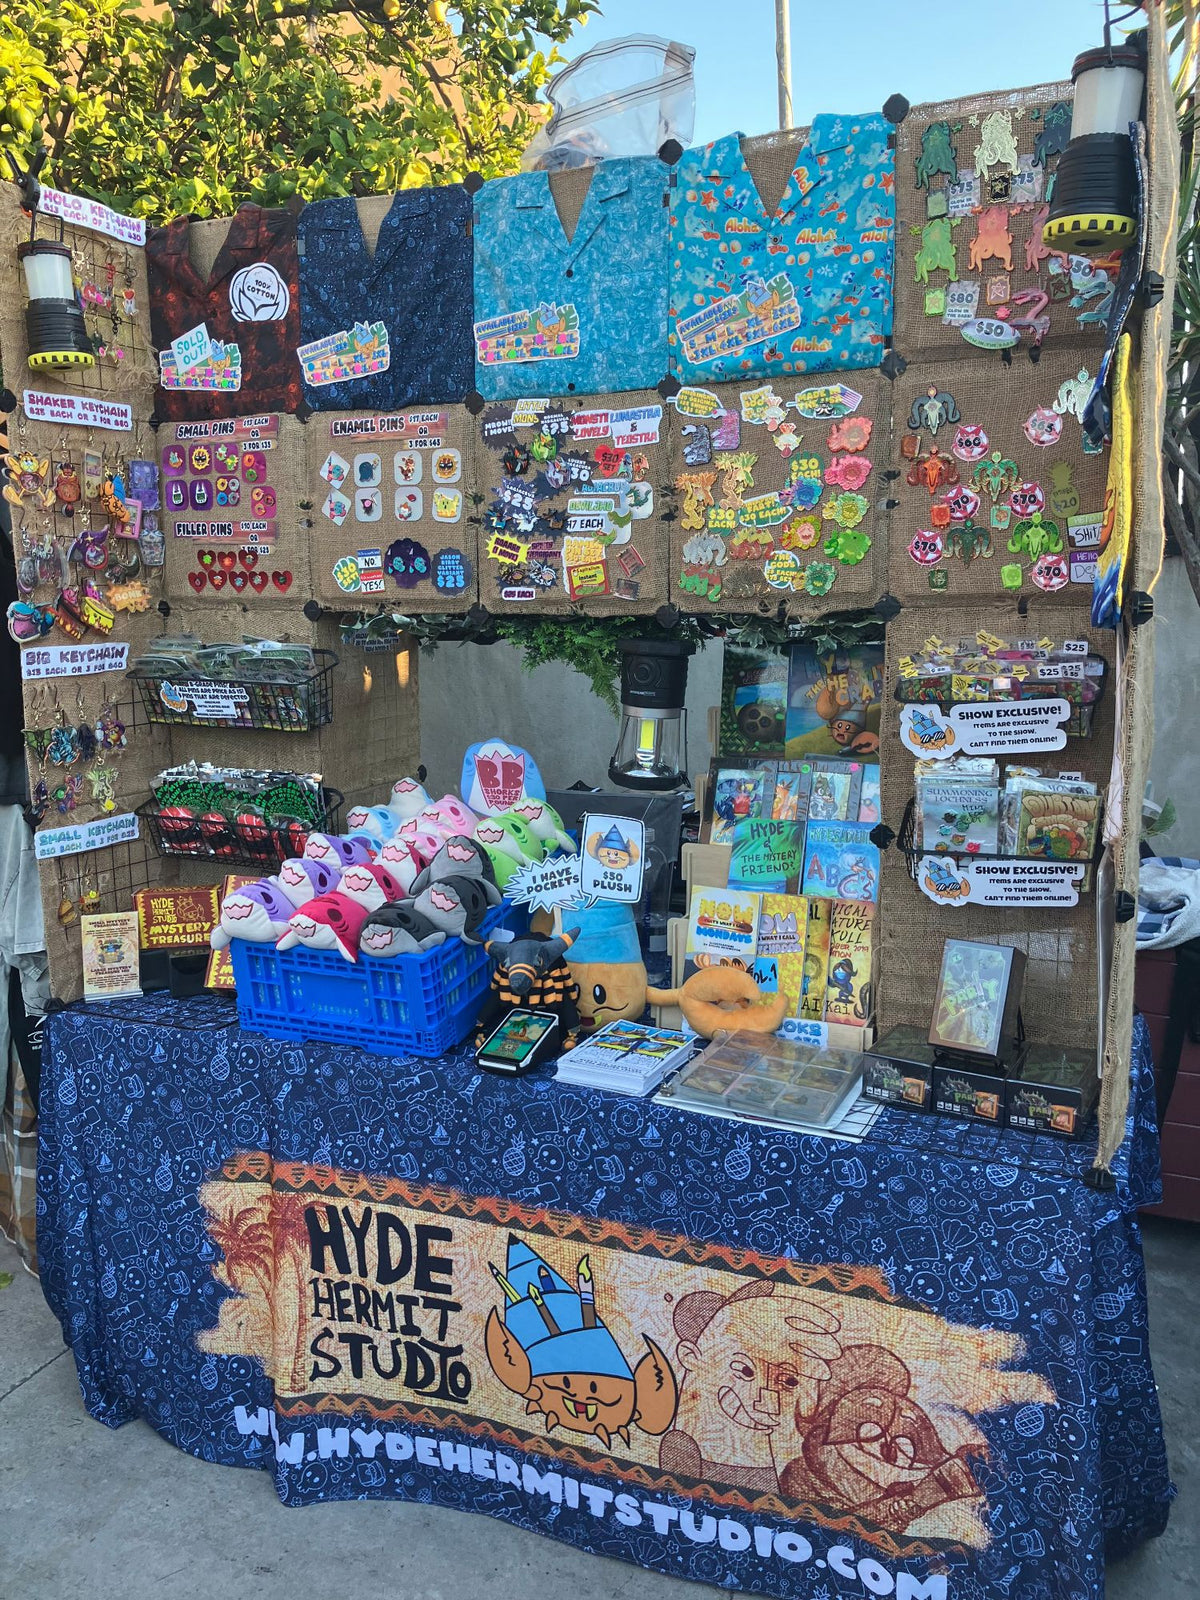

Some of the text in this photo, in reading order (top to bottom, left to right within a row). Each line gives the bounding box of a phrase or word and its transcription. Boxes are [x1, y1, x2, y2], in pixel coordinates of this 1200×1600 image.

[1011, 172, 1034, 186] $75
[950, 182, 973, 195] $75
[43, 189, 82, 211] HOLO
[725, 217, 762, 234] Aloha
[796, 228, 834, 244] Aloha
[246, 286, 276, 301] COTTON
[950, 292, 974, 304] $80
[746, 316, 763, 328] XL
[976, 322, 1004, 336] $50
[177, 331, 204, 355] SOLD
[790, 336, 832, 352] Aloha
[183, 341, 207, 365] OUT!
[28, 394, 128, 418] SHAKER KEYCHAIN
[422, 414, 438, 422] EACH
[178, 422, 235, 438] SMALL PINS
[332, 416, 405, 436] ENAMEL PINS
[250, 430, 260, 438] OR
[602, 452, 619, 462] $30
[602, 464, 615, 472] SET
[792, 458, 819, 470] $30
[503, 491, 532, 510] $25
[710, 508, 735, 520] $30
[176, 523, 233, 536] FILLER PINS
[581, 519, 604, 528] EACH
[250, 534, 259, 542] OR
[914, 542, 936, 552] $70
[1036, 566, 1060, 577] $70
[362, 580, 383, 590] YES!
[437, 576, 464, 588] $25
[1065, 644, 1085, 652] $25
[26, 646, 126, 666] BIG KEYCHAIN
[46, 667, 67, 675] EACH
[72, 666, 82, 674] OR
[1039, 668, 1059, 676] $25
[958, 710, 994, 720] SHOW
[477, 760, 523, 790] BB
[927, 788, 992, 797] SUMMONING
[40, 817, 136, 846] SMALL KEYCHAIN
[750, 822, 784, 839] HYDE
[86, 839, 96, 848] OR
[741, 850, 797, 863] THE MISTERY
[532, 867, 572, 884] I HAVE
[603, 871, 623, 881] $50
[742, 862, 796, 877] FRIEND?
[975, 866, 1010, 874] SHOW
[527, 875, 579, 895] POCKETS
[593, 880, 632, 892] PLUSH
[150, 898, 174, 909] HYDE
[699, 899, 753, 924] NOW
[149, 922, 210, 935] MYSTERY
[696, 926, 752, 944] MONDAYS
[150, 933, 211, 945] TREASURE
[826, 1000, 850, 1015] Kai
[305, 1204, 453, 1294] HYDE
[309, 1278, 462, 1342] HERMIT
[310, 1328, 472, 1404] STUDIO
